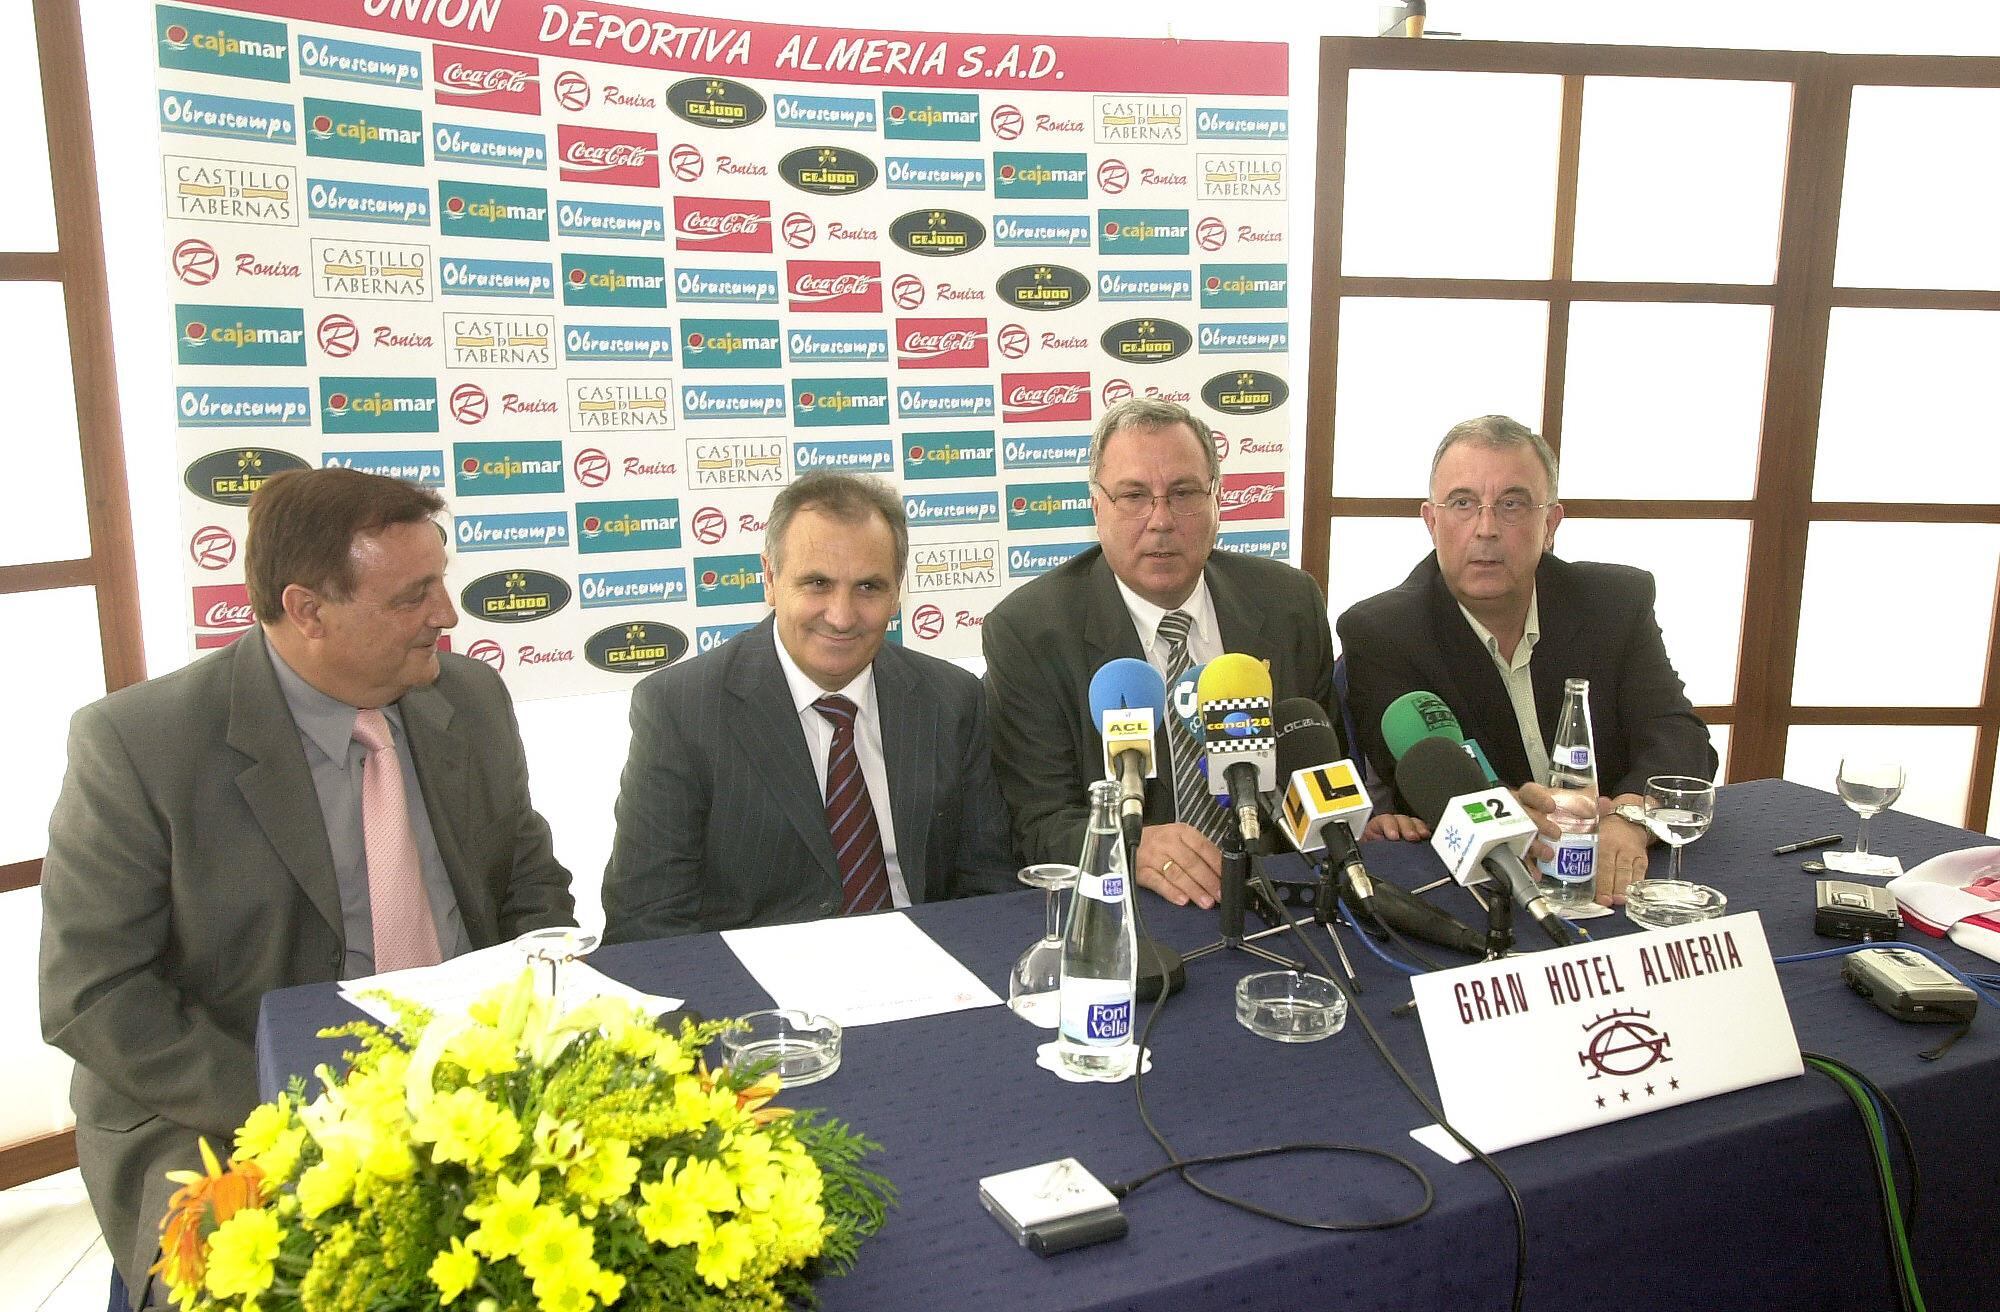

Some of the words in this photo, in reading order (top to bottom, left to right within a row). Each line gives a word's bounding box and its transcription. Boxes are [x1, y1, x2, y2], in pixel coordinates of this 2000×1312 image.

[192, 30, 287, 59] cajamar
[538, 4, 751, 65] DEPORTIVA
[774, 35, 948, 76] ALMERIA
[957, 44, 1065, 80] S.A.D.
[302, 41, 418, 83] Obrascampo
[442, 62, 528, 93] Coca-Cola
[603, 85, 656, 109] Ronixa
[163, 96, 291, 139] Obrascampo
[776, 98, 873, 128] Obrascampo
[908, 106, 978, 127] cajamar
[1102, 103, 1182, 116] CASTILLO
[336, 120, 421, 144] cajamar
[1035, 114, 1084, 132] Ronixa
[1103, 126, 1182, 140] TABERNAS
[1198, 112, 1287, 137] Obrascampo
[436, 128, 544, 165] Obrascampo
[567, 141, 647, 167] Coca-Cola
[716, 155, 768, 176] Ronixa
[887, 161, 982, 188] Obrascampo
[1018, 164, 1086, 186] cajamar
[1205, 160, 1282, 173] CASTILLO
[177, 165, 289, 190] CASTILLO
[1141, 168, 1187, 186] Ronixa
[1205, 182, 1281, 196] TABERNAS
[177, 196, 290, 220] TABERNAS
[310, 184, 426, 220] Obrascampo
[468, 198, 547, 222] cajamar
[560, 205, 662, 236] Obrascampo
[682, 211, 758, 234] Coca-Cola
[828, 222, 878, 240] Ronixa
[1122, 222, 1188, 240] cajamar
[996, 219, 1088, 244] Obrascampo
[1237, 225, 1282, 242] Ronixa
[235, 253, 302, 278] Ronixa
[322, 248, 424, 267] CASTILLO
[322, 276, 425, 295] TABERNAS
[442, 262, 550, 294] Obrascampo
[589, 269, 664, 292] cajamar
[677, 272, 776, 302] Obrascampo
[795, 273, 869, 294] Coca-Cola
[1100, 275, 1189, 298] Obrascampo
[1223, 276, 1286, 295] cajamar
[936, 283, 986, 301] Ronixa
[211, 322, 303, 348] cajamar
[373, 326, 434, 348] Ronixa
[454, 321, 549, 337] CASTILLO
[1201, 327, 1286, 350] Obrascampo
[567, 330, 669, 358] Obrascampo
[707, 332, 778, 355] cajamar
[790, 333, 885, 359] Obrascampo
[904, 331, 975, 351] Coca-Cola
[1041, 332, 1089, 349] Ronixa
[454, 348, 549, 363] TABERNAS
[502, 393, 559, 414] Ronixa
[577, 386, 666, 400] CASTILLO
[685, 390, 782, 415] Obrascampo
[817, 391, 887, 412] cajamar
[900, 390, 992, 414] Obrascampo
[1009, 385, 1079, 404] Coca-Cola
[180, 391, 306, 422] Obrascampo
[352, 392, 436, 416] cajamar
[578, 411, 668, 427] TABERNAS
[696, 444, 782, 459] CASTILLO
[927, 445, 993, 465] cajamar
[1005, 442, 1092, 464] Obrascamp
[1240, 438, 1284, 455] Ronixa
[483, 456, 562, 480] cajamar
[623, 456, 677, 477] Ronixa
[796, 446, 890, 471] Obrascampo
[696, 467, 783, 484] TABERNAS
[906, 500, 996, 521] Obrascampo
[458, 520, 565, 545] Obrascampo
[604, 514, 678, 537] cajamar
[914, 546, 994, 564] CASTILLO
[1213, 538, 1288, 557] brascampo
[1010, 550, 1077, 570] Obrasca
[721, 568, 764, 589] caja
[915, 570, 995, 586] TABERNAS
[582, 578, 683, 600] Obrascampo
[518, 645, 575, 666] Ronixa
[1109, 722, 1148, 732] ACL
[1312, 769, 1360, 802] L
[1486, 798, 1512, 818] 2
[1561, 849, 1590, 862] Font
[1561, 862, 1590, 875] Vella
[1454, 972, 1529, 1025] GRAN
[1544, 954, 1625, 1006] HOTEL
[1639, 931, 1743, 987] ALMERIA
[1092, 1004, 1128, 1021] Font
[1091, 1020, 1128, 1038] Vella
